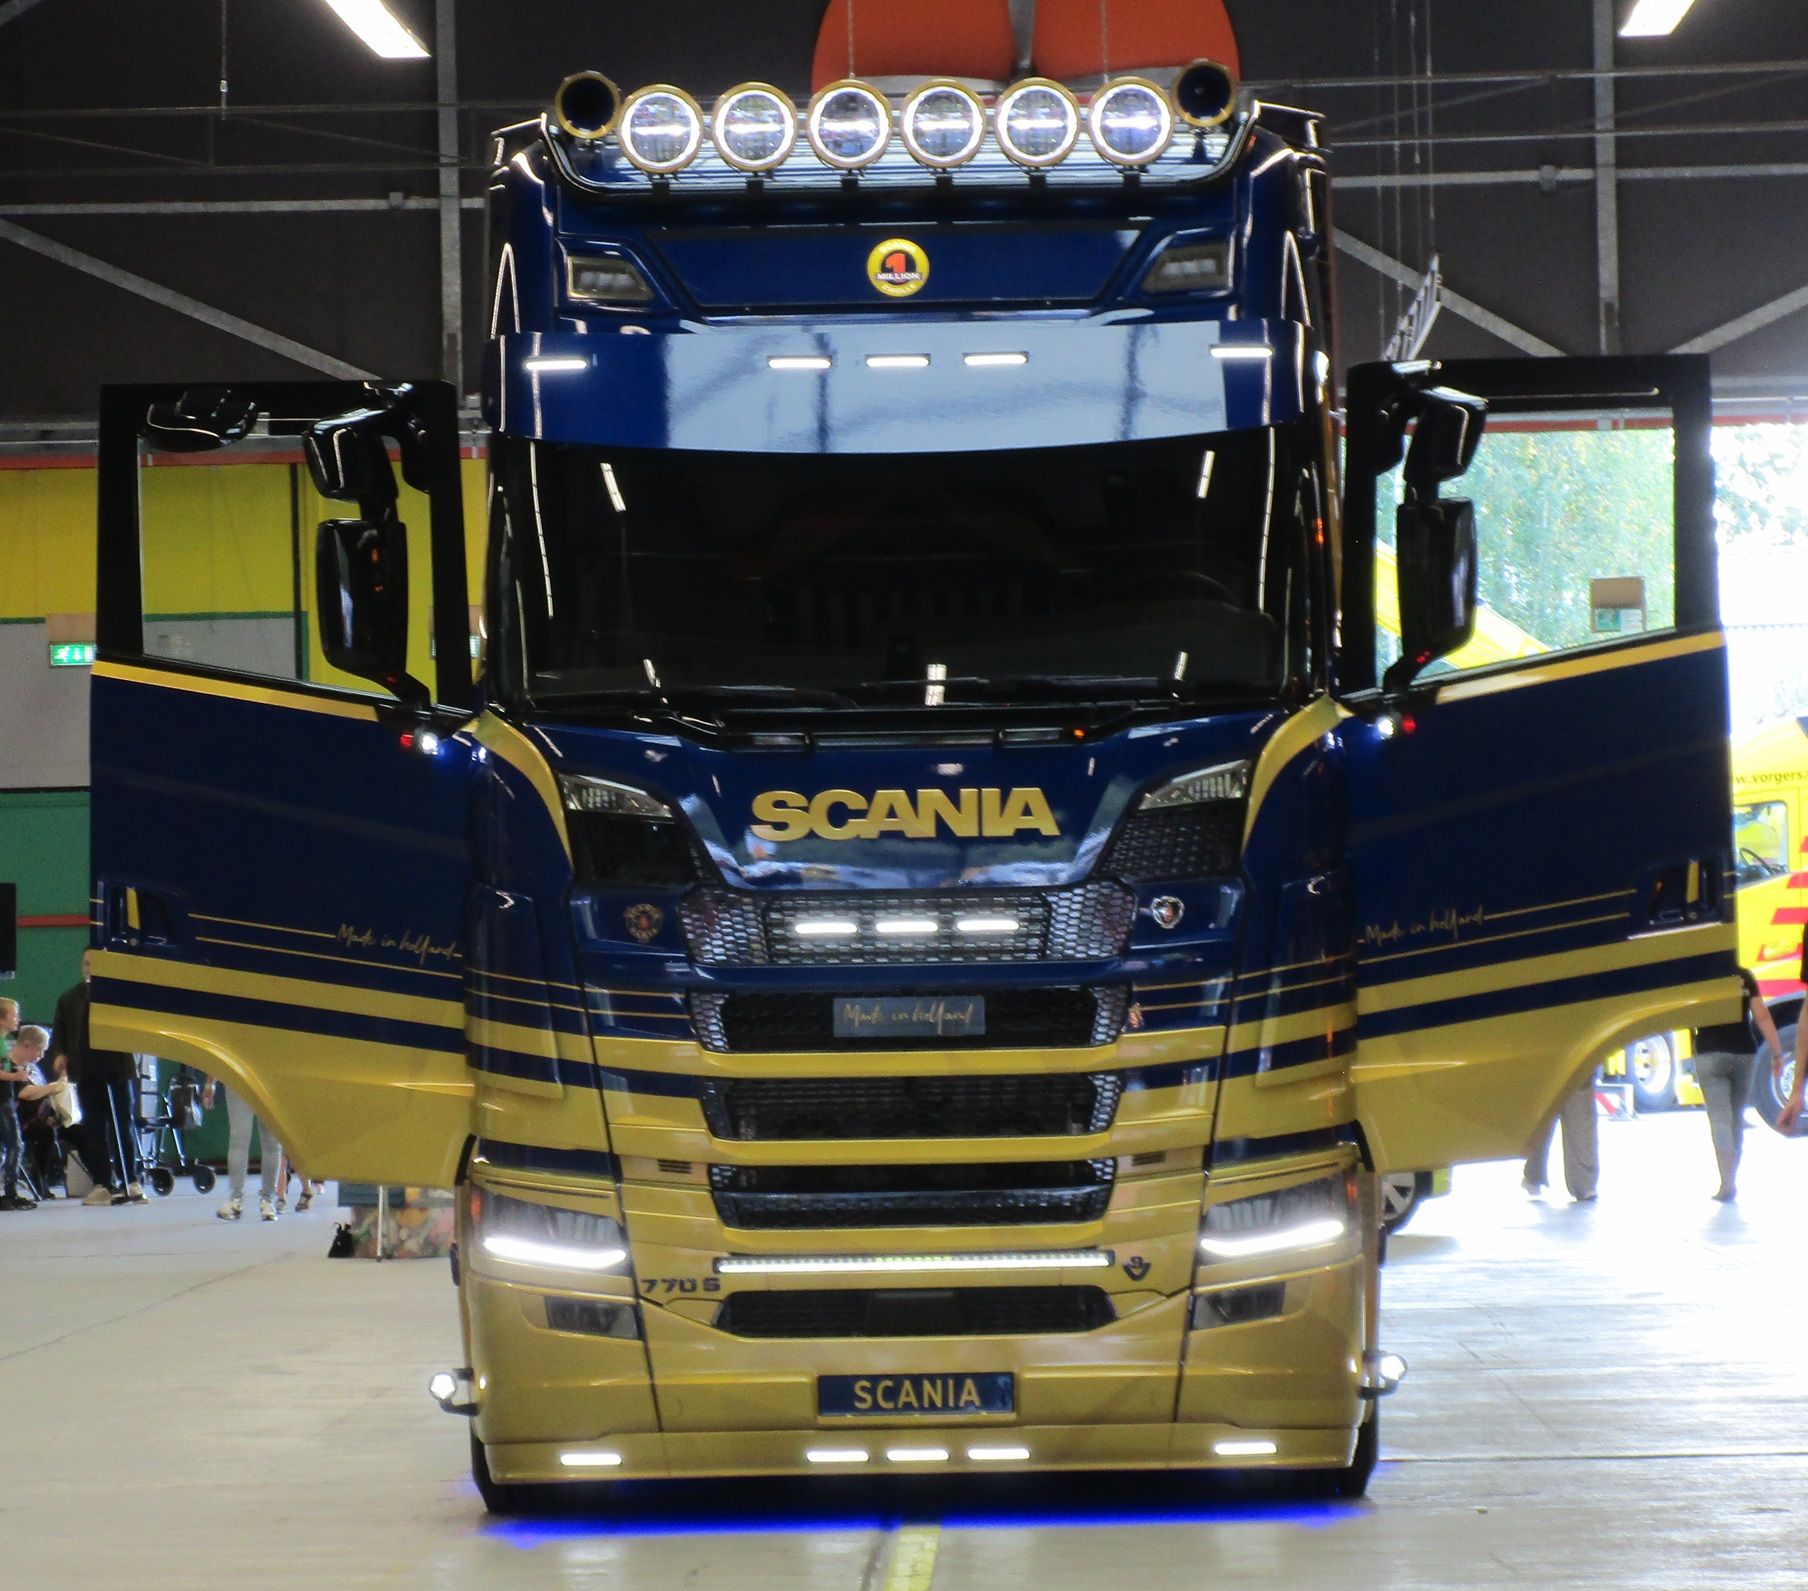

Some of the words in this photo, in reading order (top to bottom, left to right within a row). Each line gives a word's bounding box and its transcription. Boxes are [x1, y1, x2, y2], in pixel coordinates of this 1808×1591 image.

[885, 252, 906, 275] 1
[876, 272, 922, 281] MILLION
[1731, 770, 1808, 785] w.vorgers.
[751, 787, 1062, 841] SCANIA
[641, 1278, 697, 1293] 770
[703, 1277, 720, 1292] S
[853, 1378, 981, 1409] SCANIA
